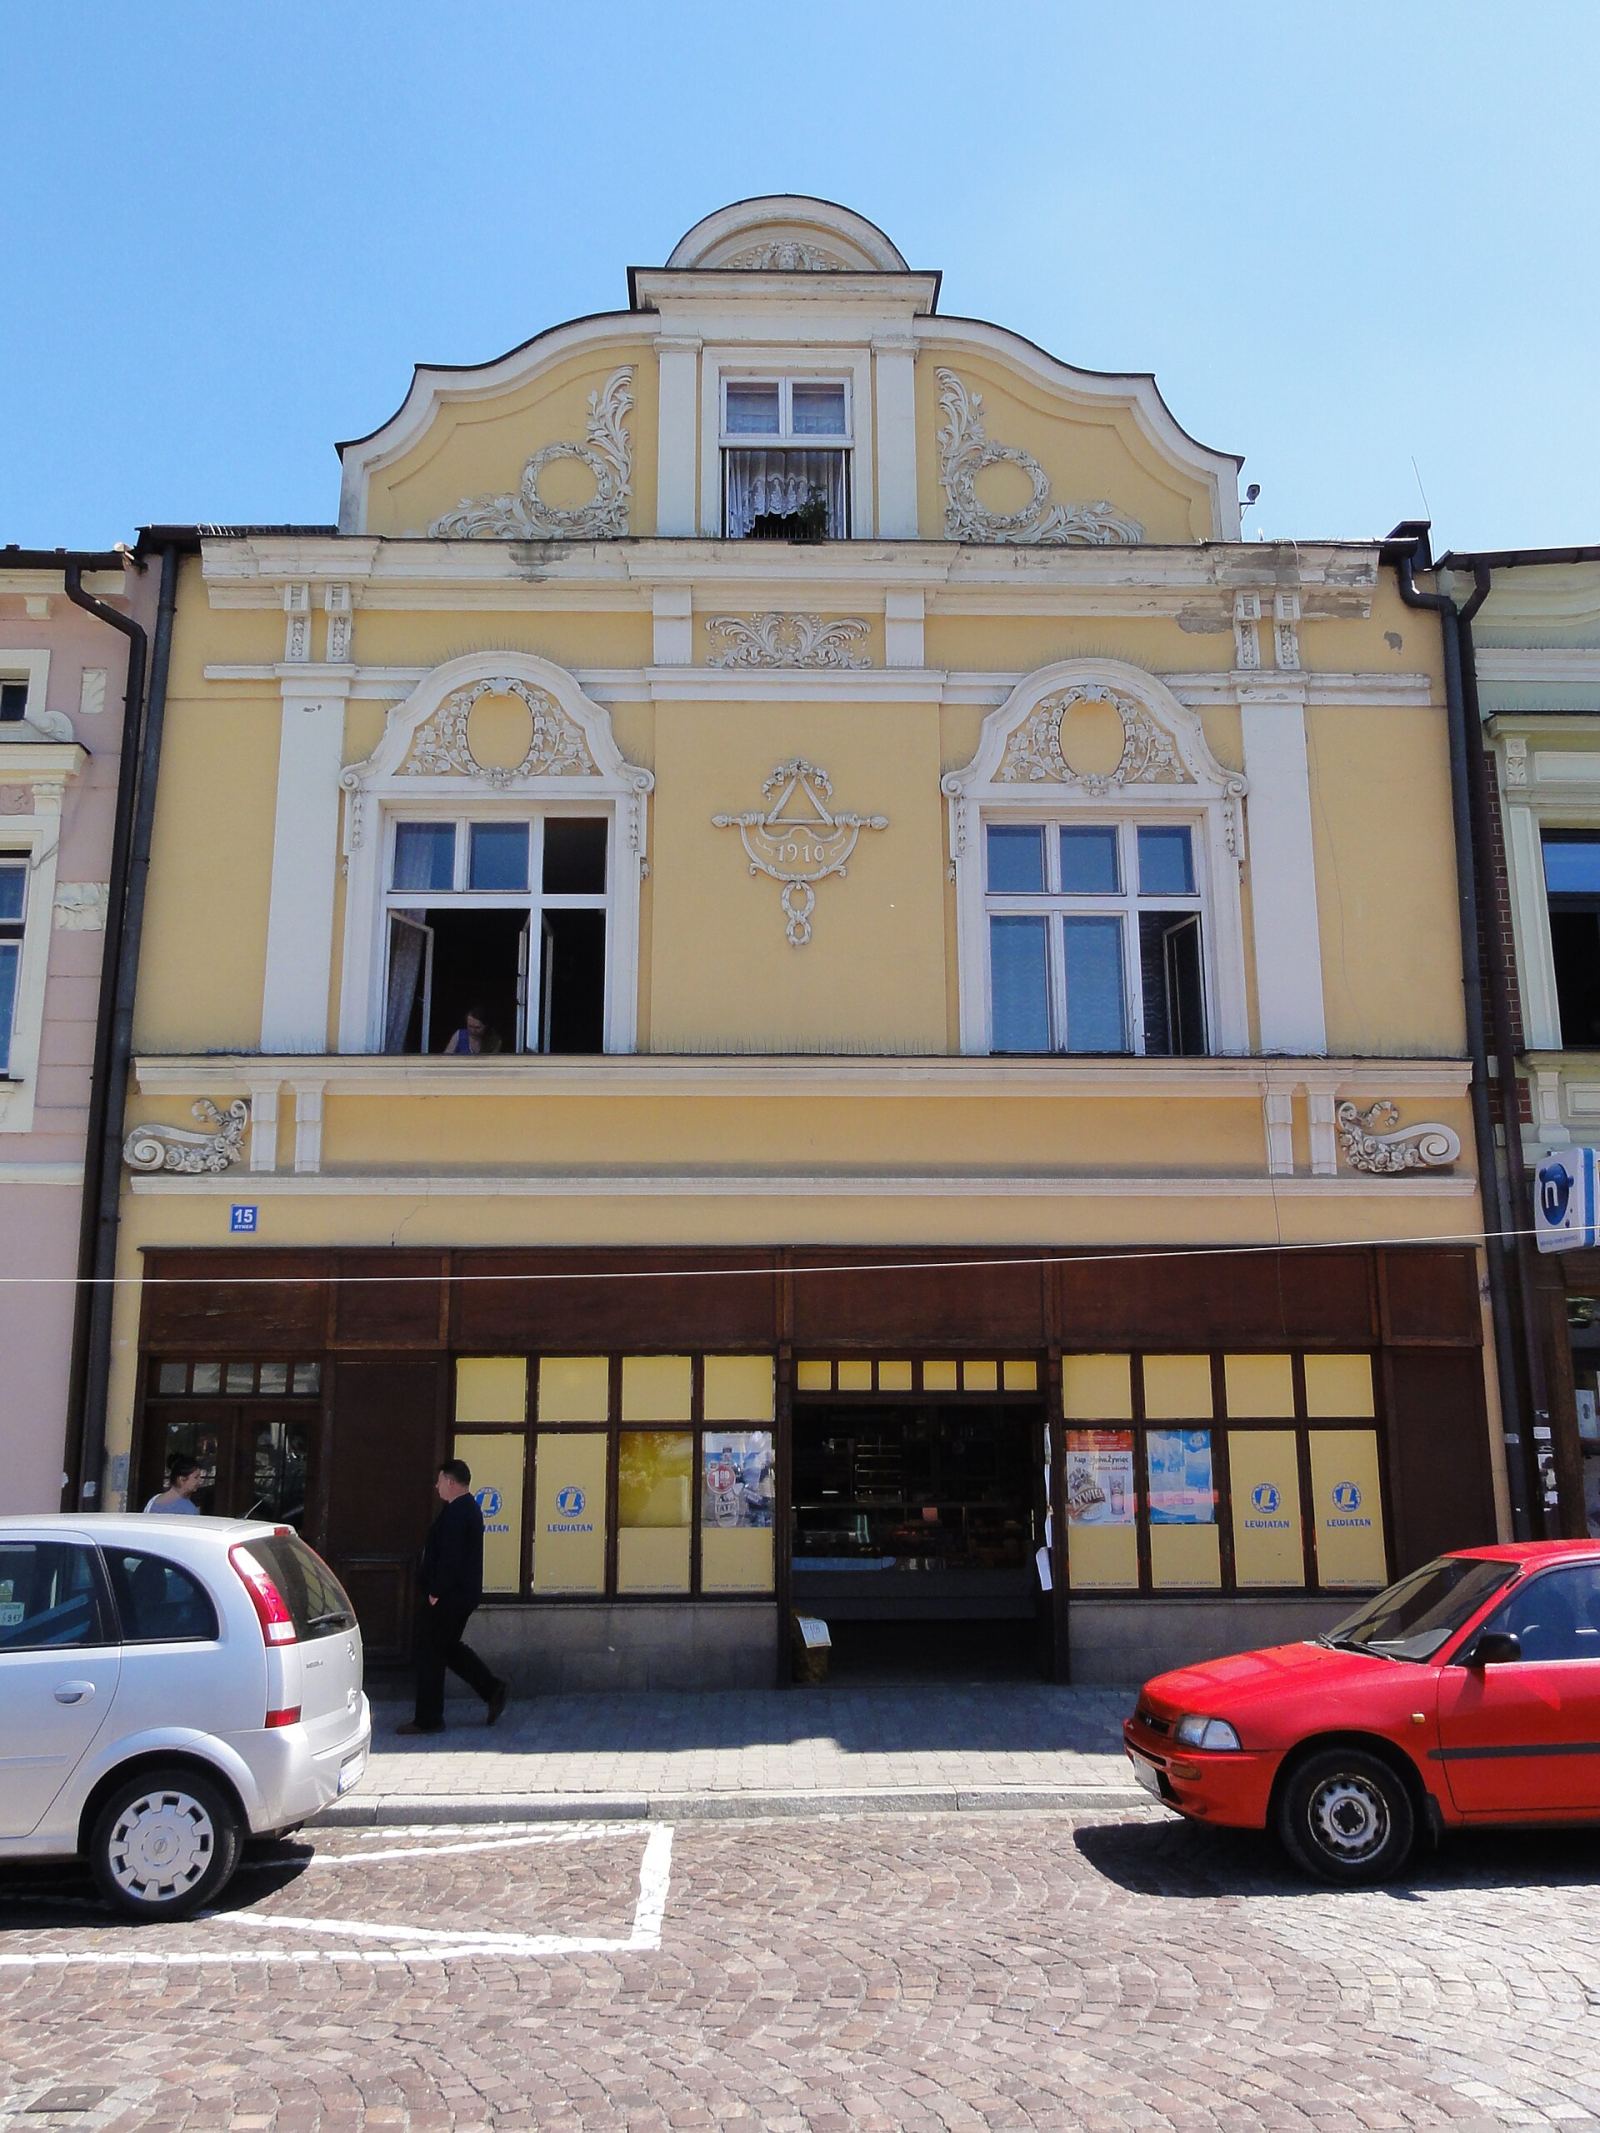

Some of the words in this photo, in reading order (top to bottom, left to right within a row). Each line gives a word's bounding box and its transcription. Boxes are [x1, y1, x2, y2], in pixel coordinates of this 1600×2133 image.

[776, 844, 825, 862] 1910
[234, 1208, 254, 1224] 15
[1244, 1520, 1290, 1529] LEWIATAN
[1326, 1518, 1372, 1527] LEWIATAN
[547, 1524, 593, 1533] LEWIATAN
